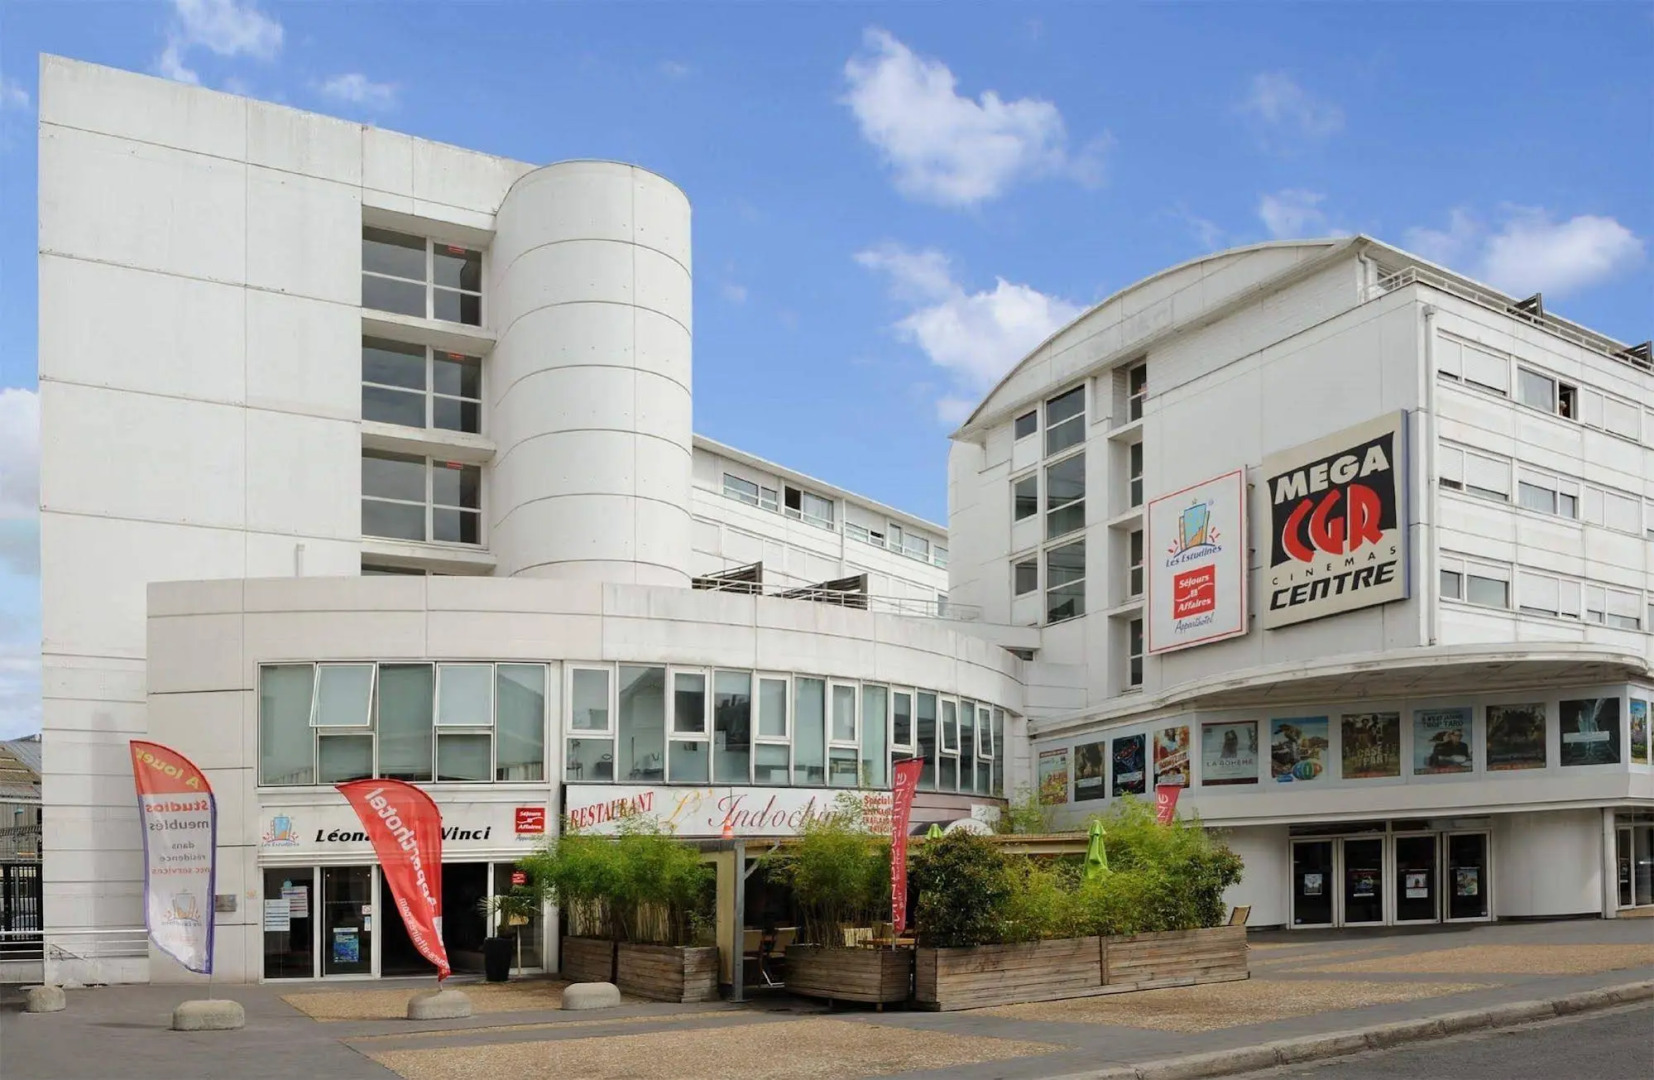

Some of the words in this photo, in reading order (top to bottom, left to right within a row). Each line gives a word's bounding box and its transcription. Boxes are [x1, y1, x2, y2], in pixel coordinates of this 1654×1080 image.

[1274, 445, 1390, 505] MEGA
[1282, 483, 1384, 563] CGR
[1166, 559, 1180, 568] Les
[1181, 545, 1222, 563] Estudines
[1272, 546, 1397, 585] CINEMAS
[1270, 560, 1398, 611] CENTRE
[1178, 598, 1212, 612] Affaires
[570, 791, 654, 829] RESTAURANT
[440, 826, 491, 840] Vinci
